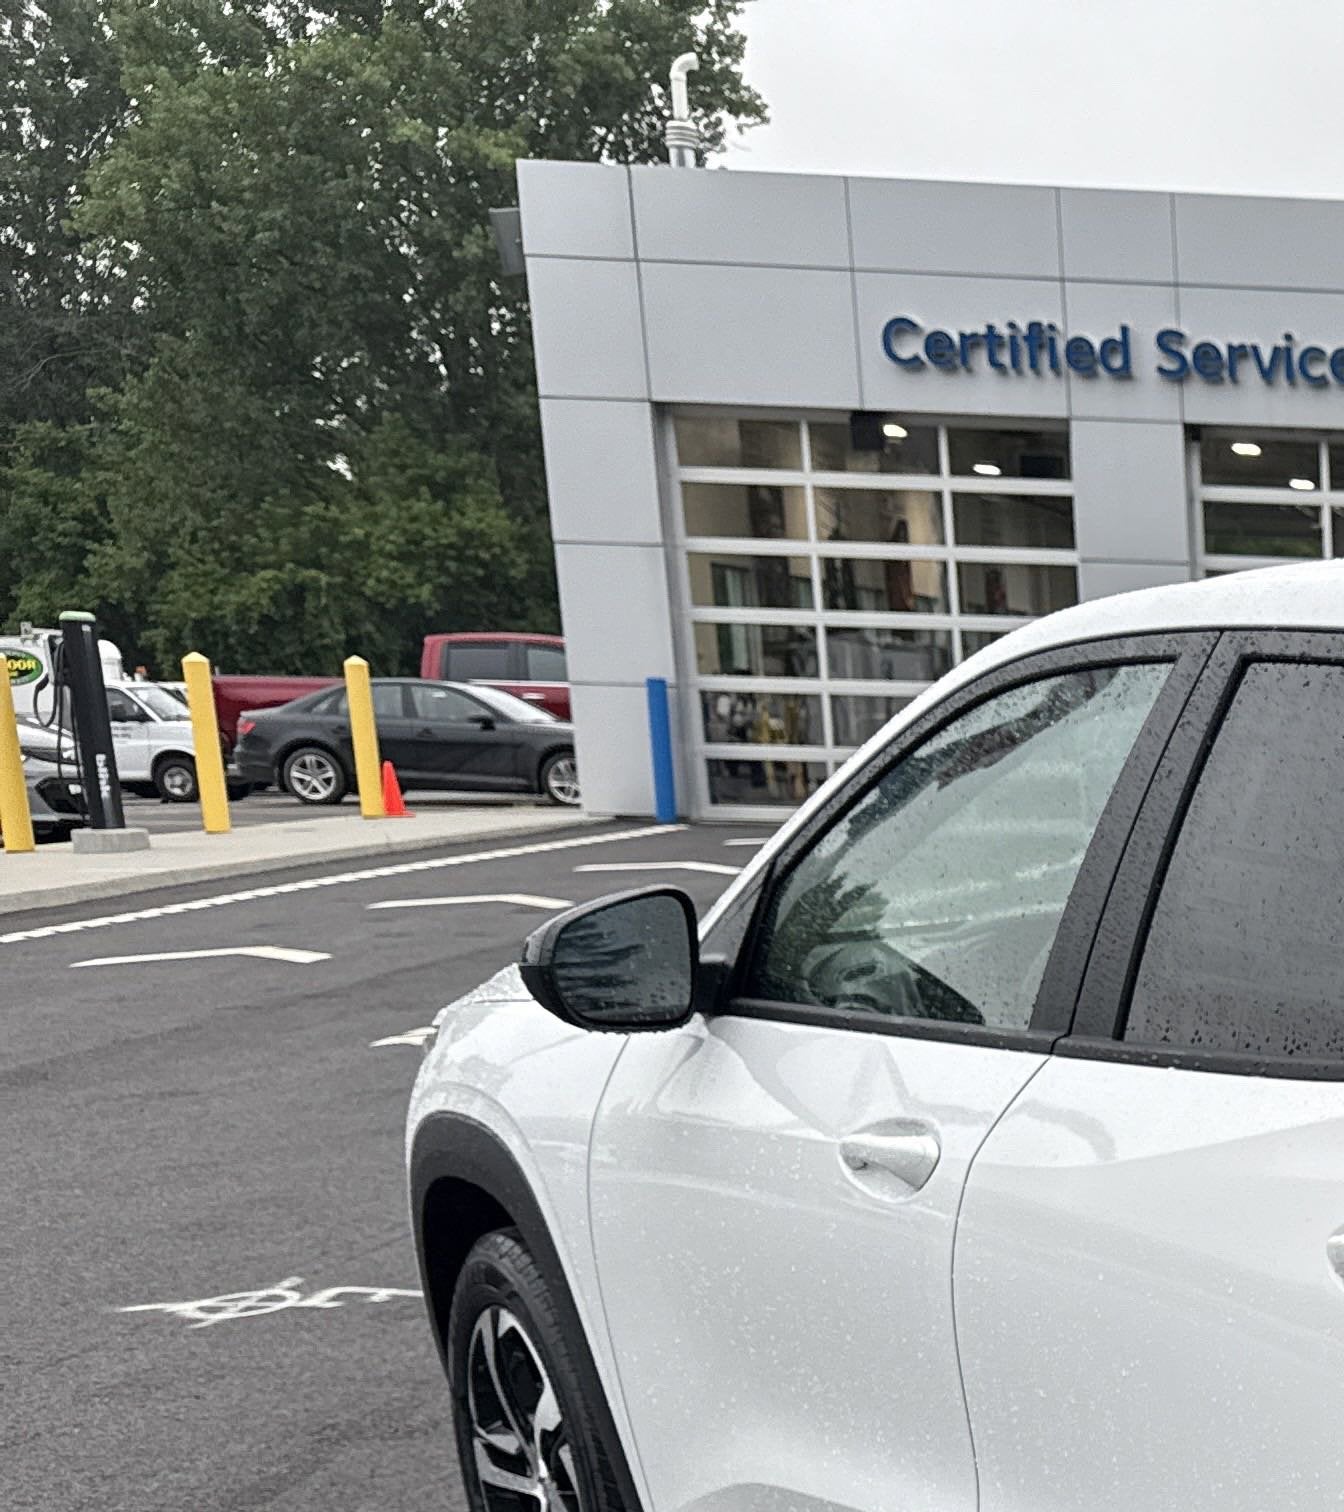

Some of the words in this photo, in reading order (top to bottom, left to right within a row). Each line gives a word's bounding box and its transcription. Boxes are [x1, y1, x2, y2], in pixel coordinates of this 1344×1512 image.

[881, 316, 1132, 376] Certified
[7, 658, 37, 671] OOR
[95, 753, 111, 800] blink
